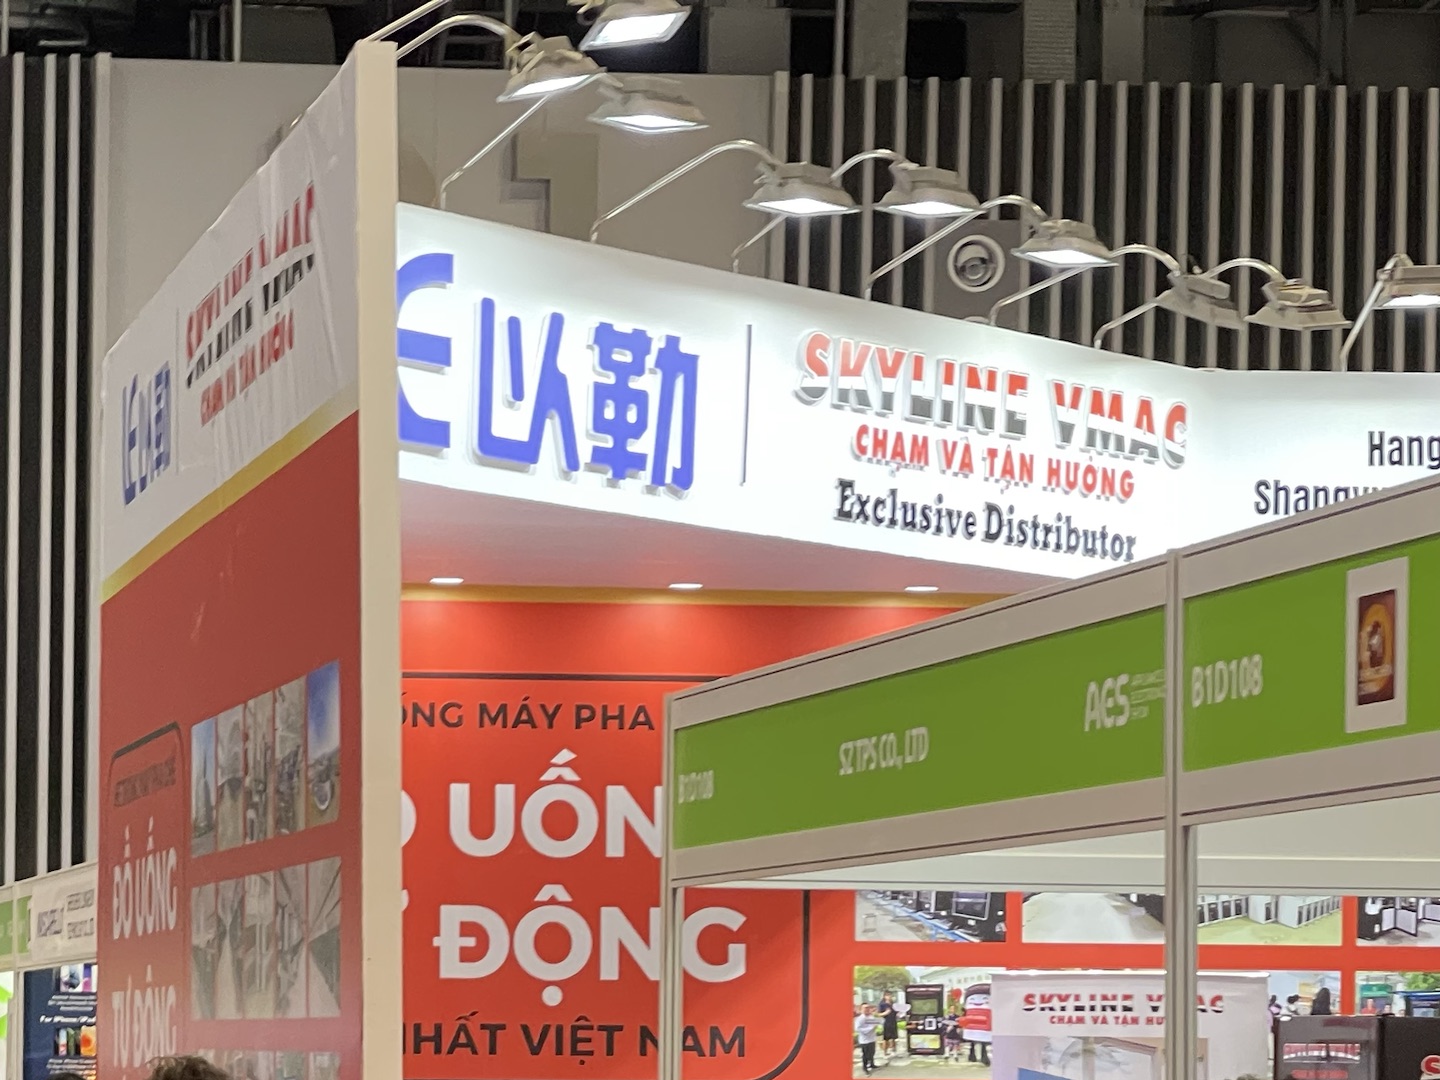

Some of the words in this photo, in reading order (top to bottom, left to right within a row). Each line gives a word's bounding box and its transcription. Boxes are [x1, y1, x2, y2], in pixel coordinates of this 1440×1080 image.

[793, 331, 1030, 441] SKYLINE
[1048, 379, 1190, 469] VMAC
[834, 478, 977, 540] Exclusive
[981, 502, 1138, 562] Distributor
[478, 695, 563, 730] MÁY
[574, 703, 656, 731] PHA
[449, 748, 663, 859] UỐN
[432, 883, 748, 1008] ĐỘNG
[402, 1010, 507, 1056] HẤT
[520, 1014, 624, 1066] VIỆT
[1022, 993, 1134, 1012] SKYLINE
[1146, 993, 1224, 1014] VAC
